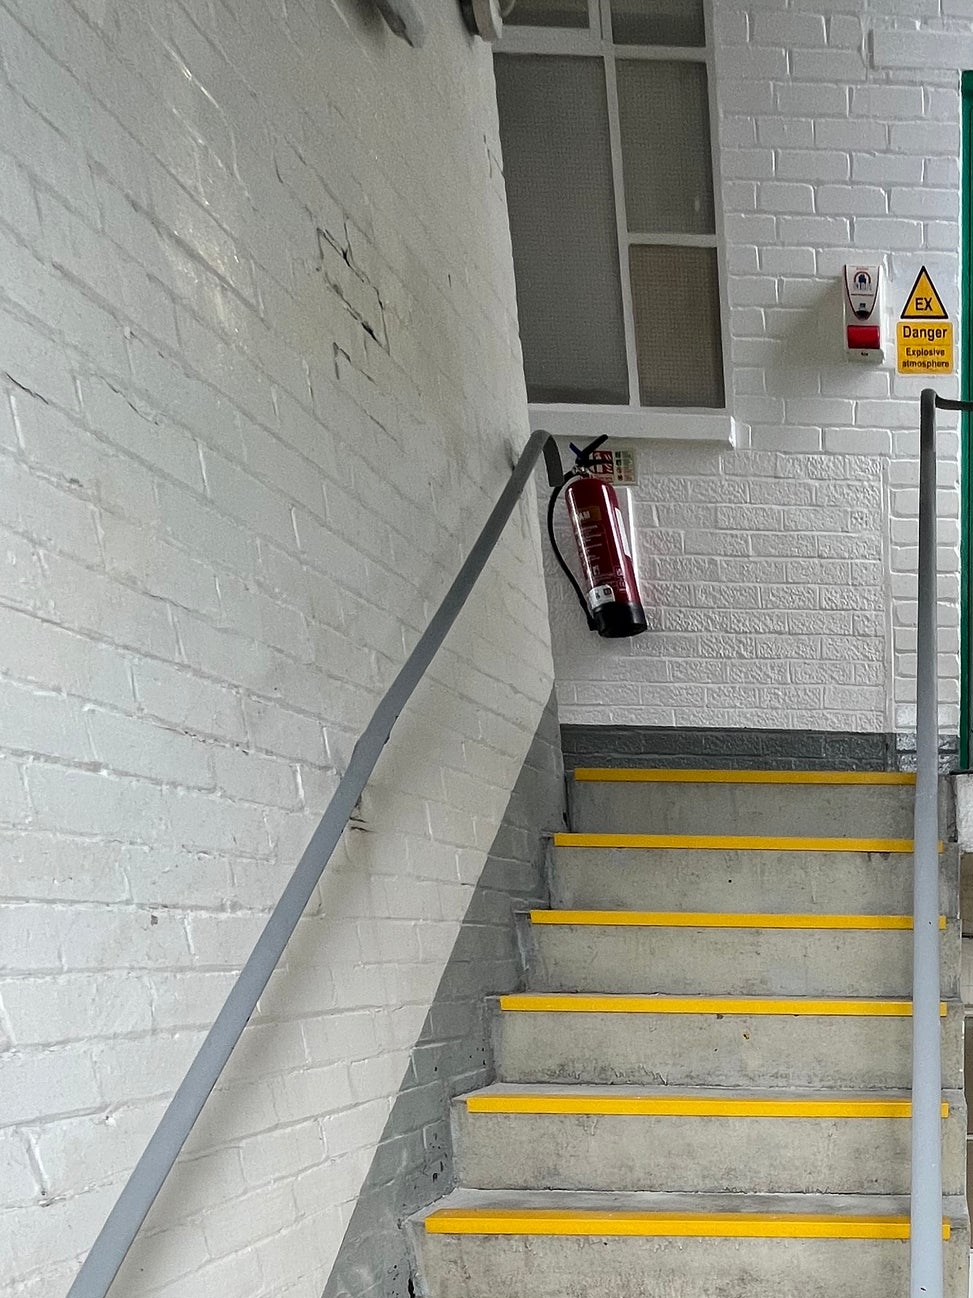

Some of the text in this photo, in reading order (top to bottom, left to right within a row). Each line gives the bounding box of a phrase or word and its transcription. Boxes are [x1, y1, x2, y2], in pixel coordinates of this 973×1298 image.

[915, 298, 933, 311] EX
[903, 326, 948, 341] Danger
[905, 347, 945, 357] Explosive
[902, 360, 949, 369] atmosphere
